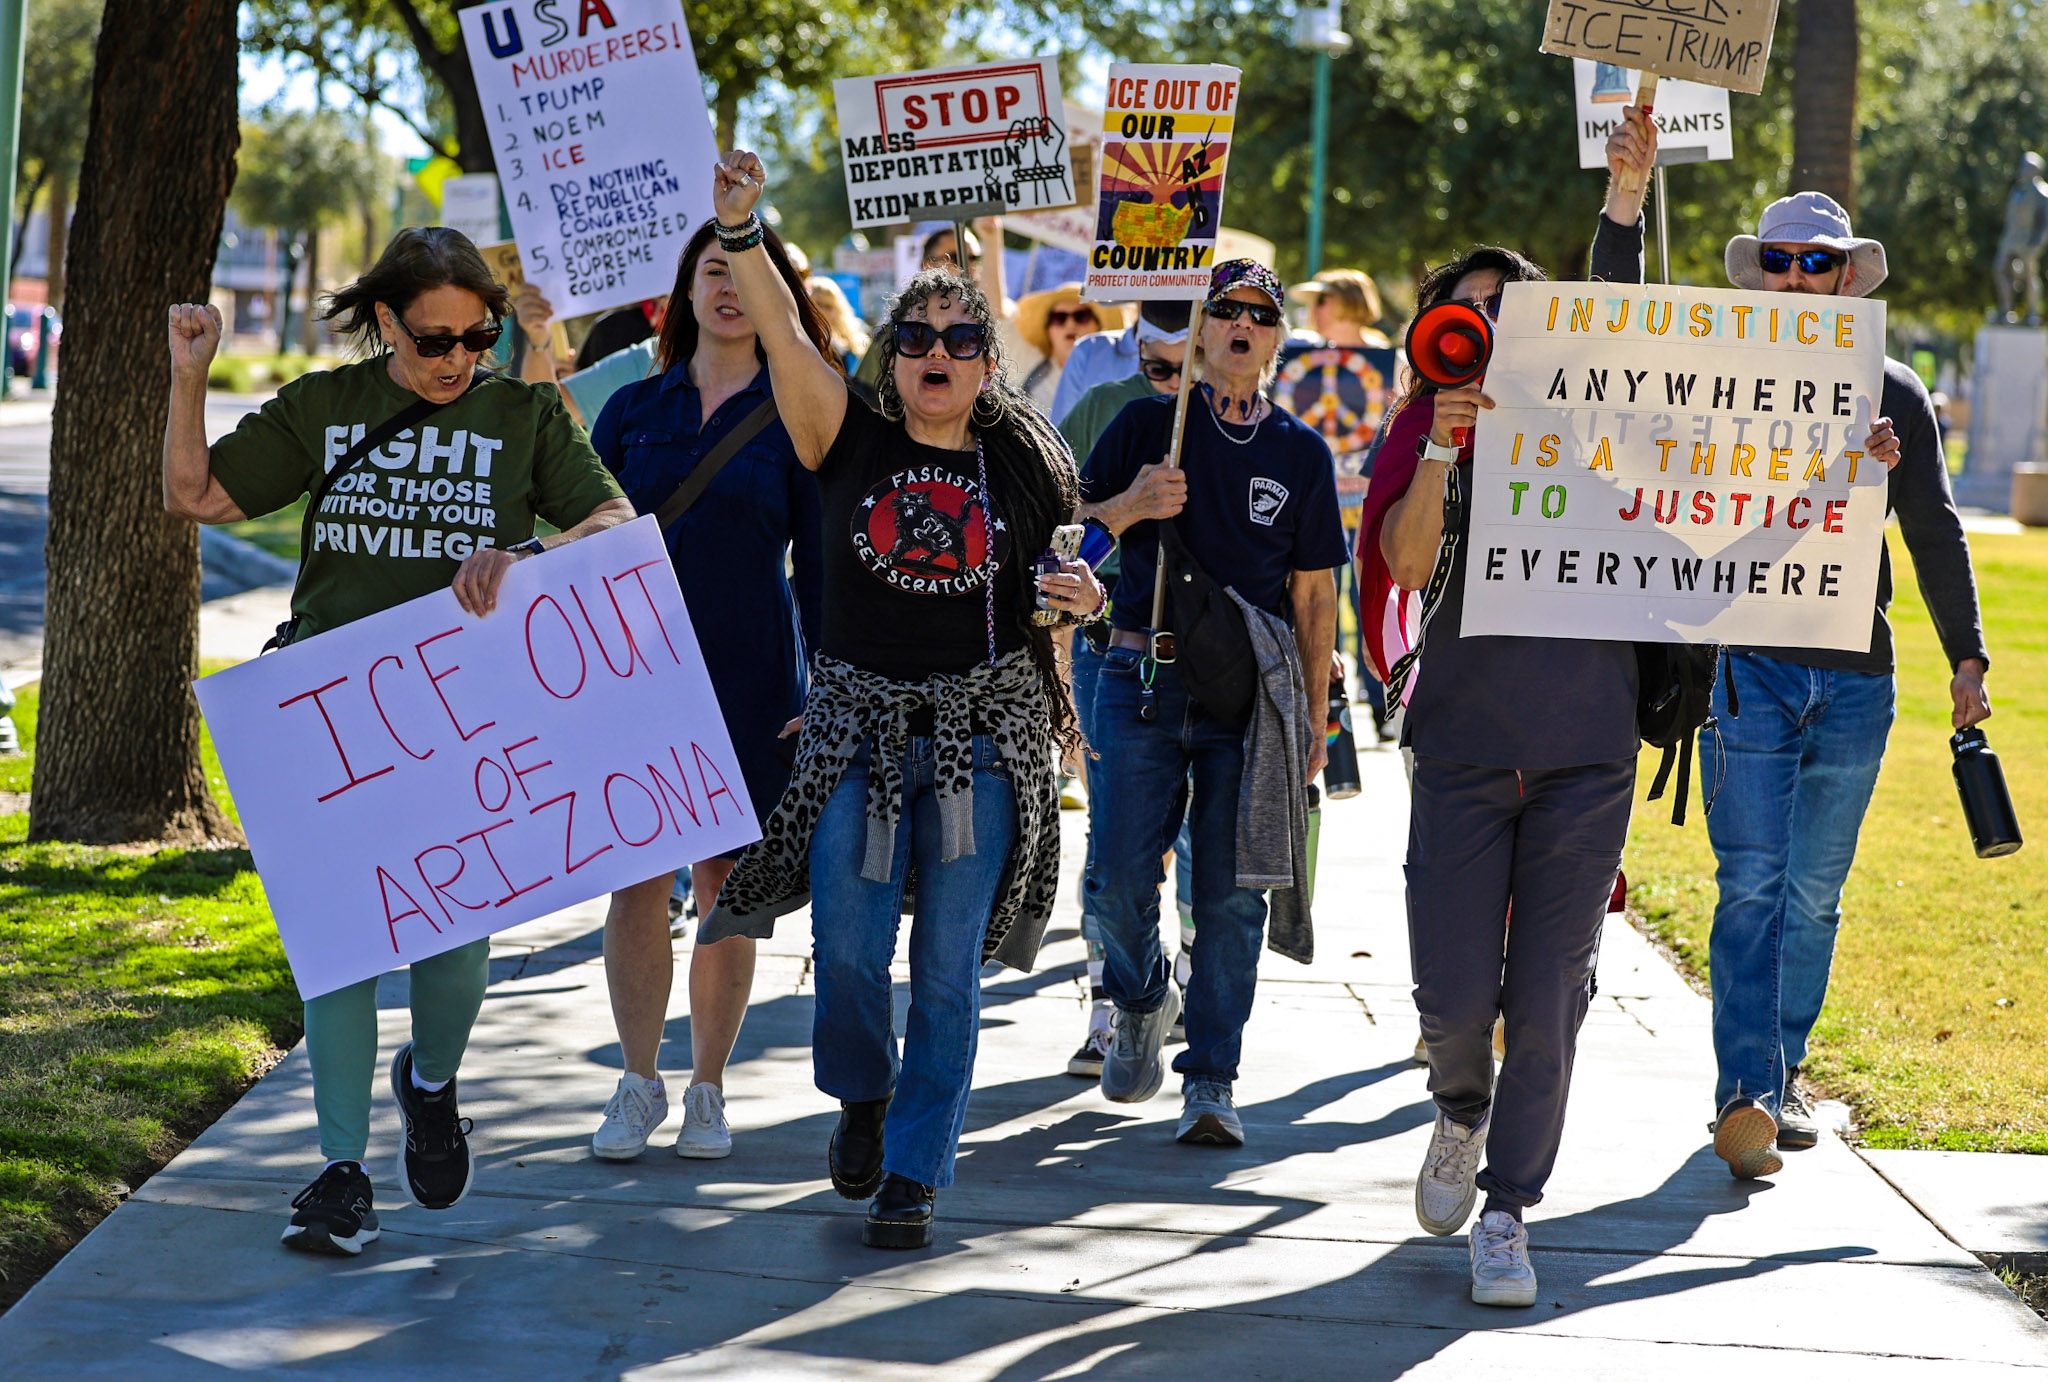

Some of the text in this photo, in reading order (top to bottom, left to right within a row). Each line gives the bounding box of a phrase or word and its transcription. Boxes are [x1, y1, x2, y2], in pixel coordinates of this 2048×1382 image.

[482, 0, 618, 58] USA
[511, 22, 682, 88] MURDERERS!
[903, 85, 1020, 130] STOP
[1108, 78, 1237, 111] ICE OUT OF
[532, 109, 605, 144] NOEM
[845, 131, 916, 159] MASS
[1121, 113, 1176, 140] OUR
[1585, 112, 1726, 139] IMRANTS
[542, 144, 585, 171] ICE
[849, 145, 1022, 184] DEPORTATION
[983, 166, 1000, 187] &
[550, 158, 668, 204] DO NOTHING
[557, 176, 679, 221] REPUBLICAN
[559, 200, 658, 239] CONGRESS
[564, 243, 654, 282] SUPREME
[1093, 244, 1208, 272] COUNTRY
[568, 271, 627, 297] COURT
[1088, 273, 1129, 287] PROTECT
[1130, 274, 1149, 287] OUR
[1547, 296, 1854, 348] INJUSTICE
[1547, 367, 1852, 416] ANYWHERE
[1510, 433, 1865, 483] IS A THREAT
[387, 475, 492, 505] THOSE
[1254, 480, 1286, 500] PARMA
[1508, 482, 1847, 533] TO JUSTICE
[319, 494, 497, 528] WITHOUT YOUR
[1252, 511, 1271, 523] POLICE
[1485, 546, 1842, 597] EVERYWHERE
[278, 558, 681, 802] ICE OUT
[474, 735, 553, 813] OF
[376, 741, 744, 954] ARIZONA
